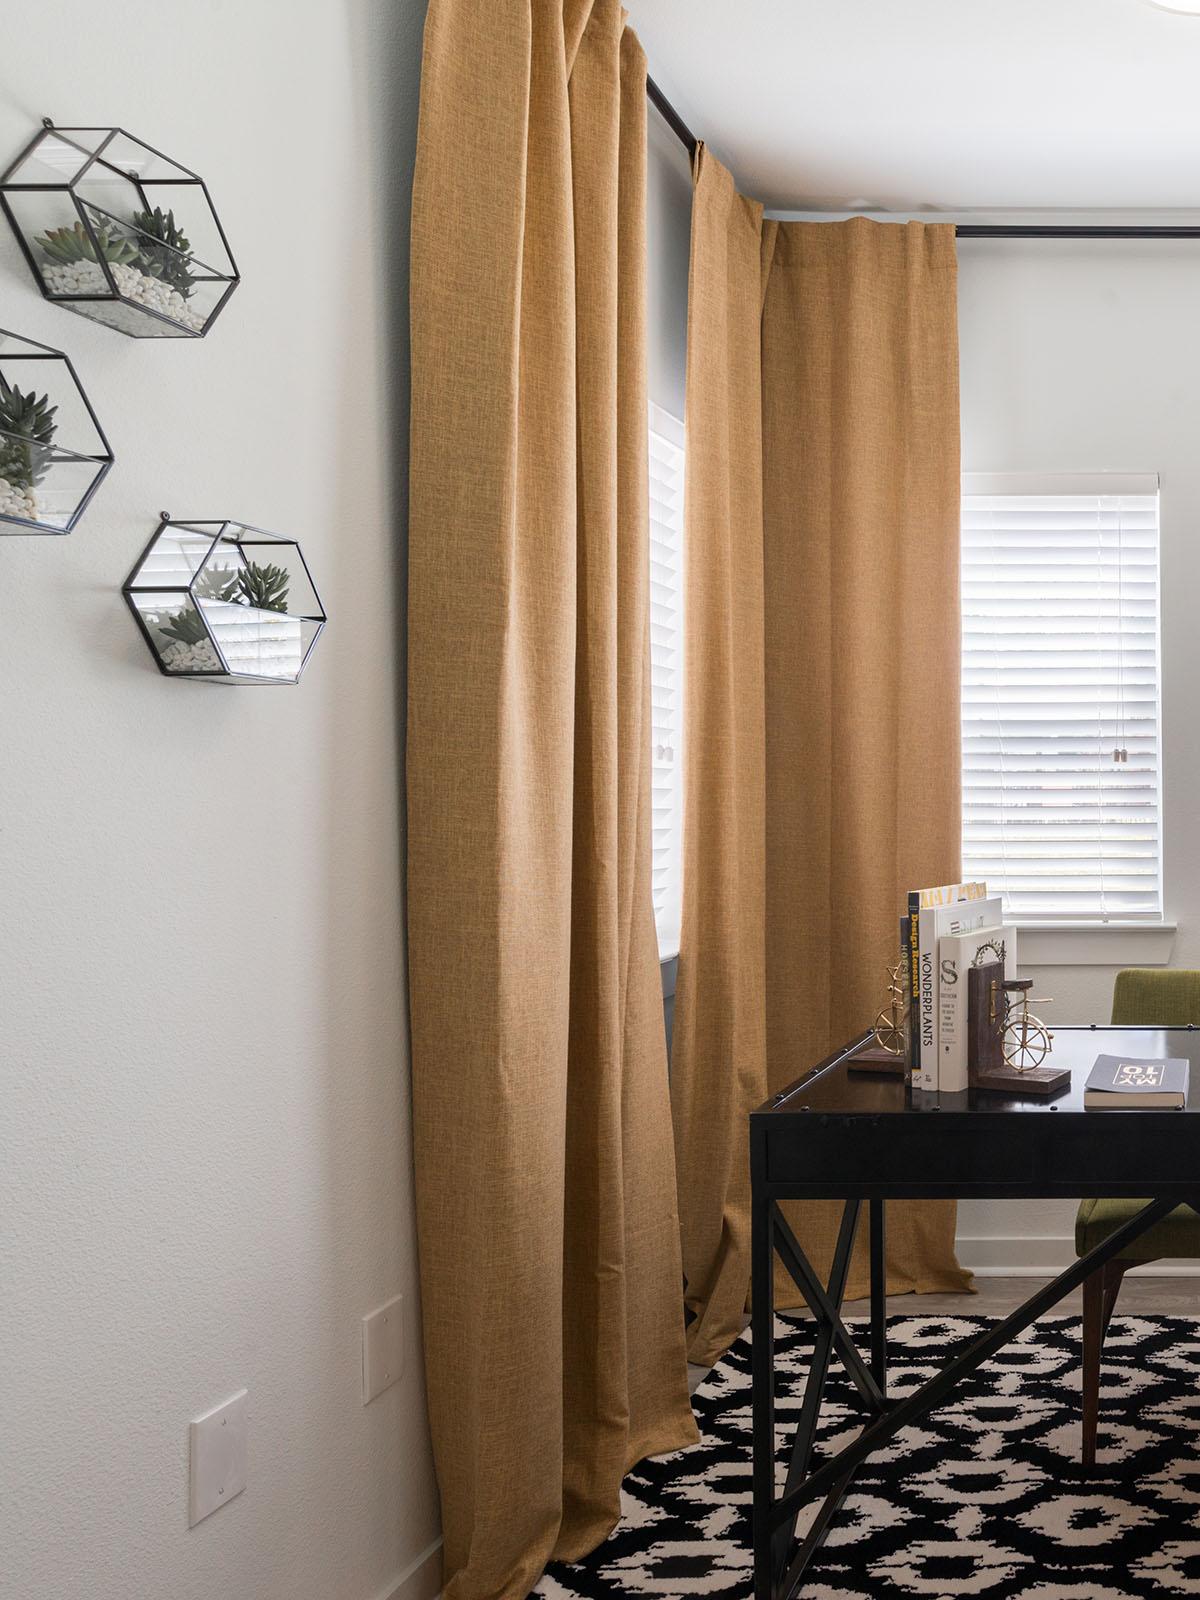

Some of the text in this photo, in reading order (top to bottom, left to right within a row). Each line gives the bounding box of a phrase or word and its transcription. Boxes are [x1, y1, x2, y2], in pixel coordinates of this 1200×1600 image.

[910, 914, 919, 948] Design
[941, 959, 958, 985] S
[922, 952, 932, 1046] WONDERPLANTS
[1123, 1066, 1158, 1075] 10
